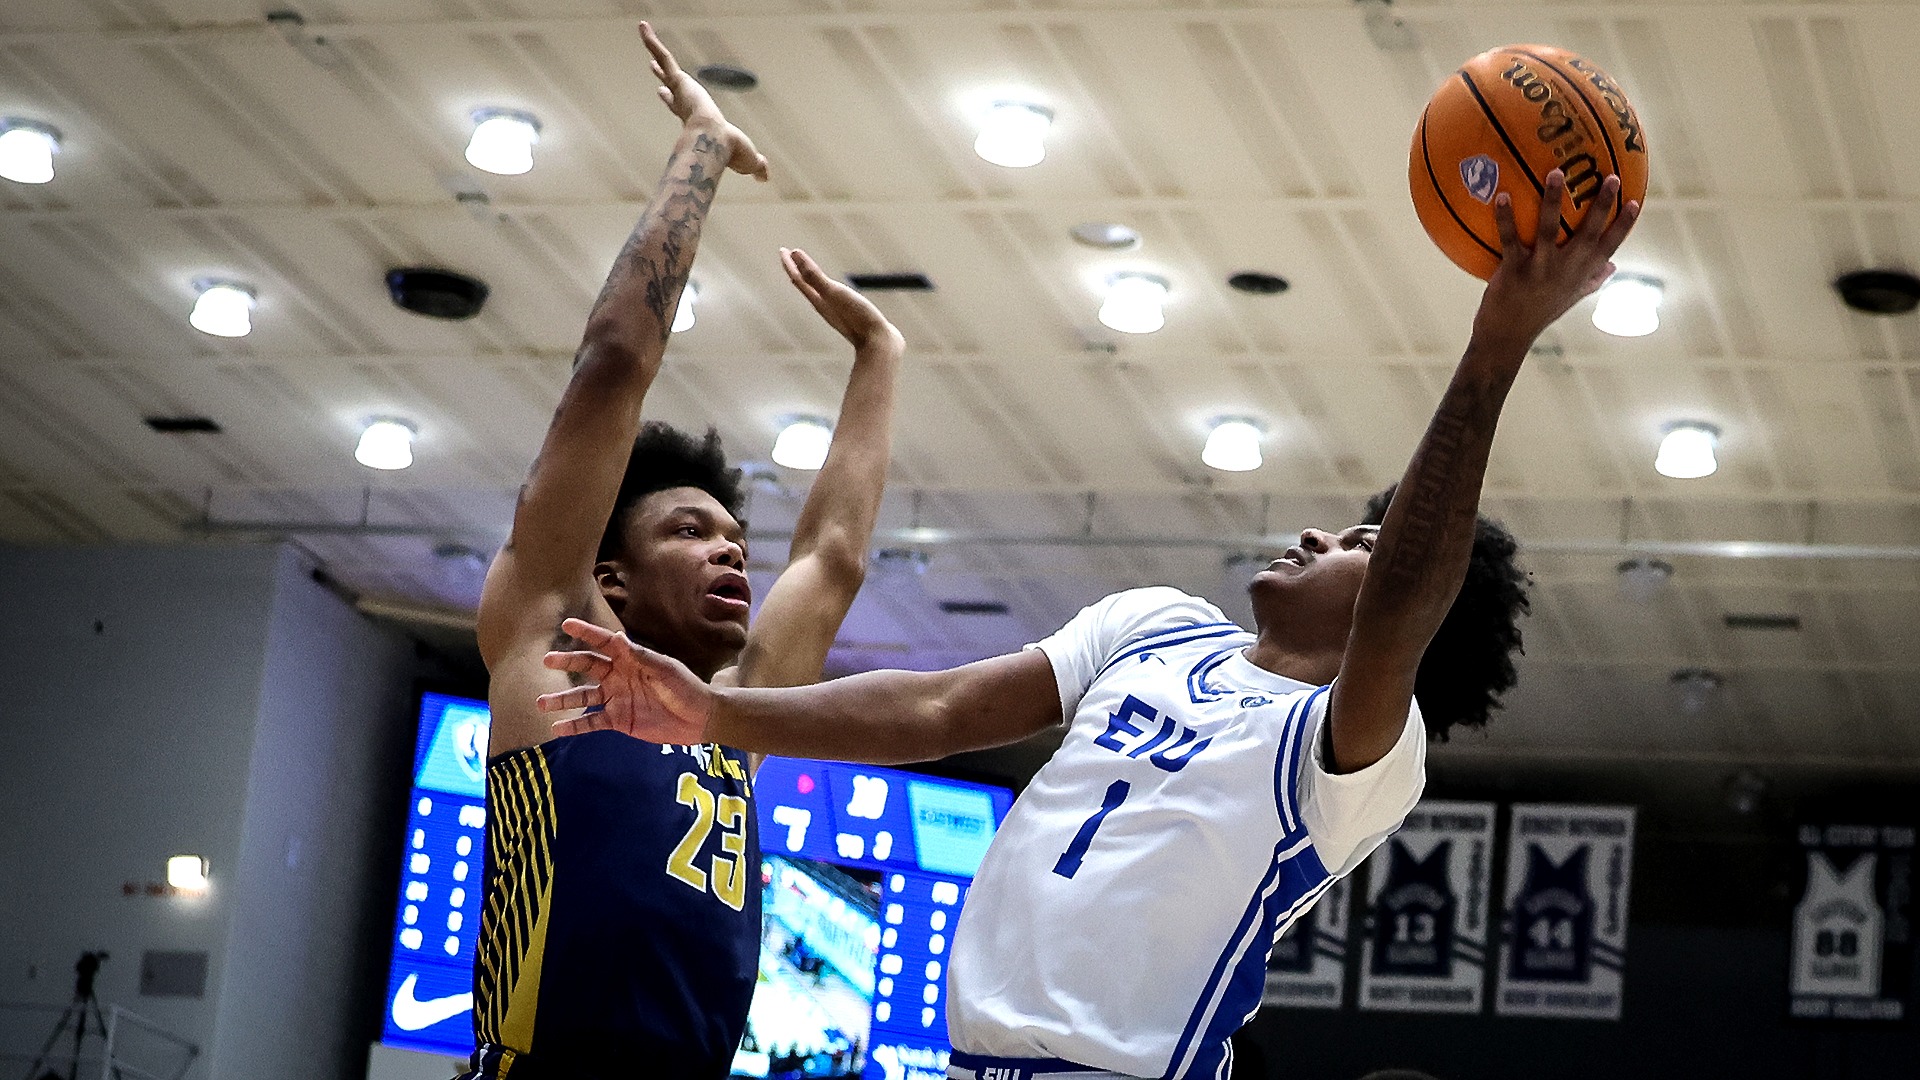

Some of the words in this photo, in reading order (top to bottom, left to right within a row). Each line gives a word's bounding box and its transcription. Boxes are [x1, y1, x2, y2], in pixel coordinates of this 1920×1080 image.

[1500, 57, 1604, 211] Wilson
[1093, 694, 1213, 772] EIU
[666, 772, 746, 911] 23
[1052, 779, 1131, 879] 1
[1395, 912, 1436, 942] 13
